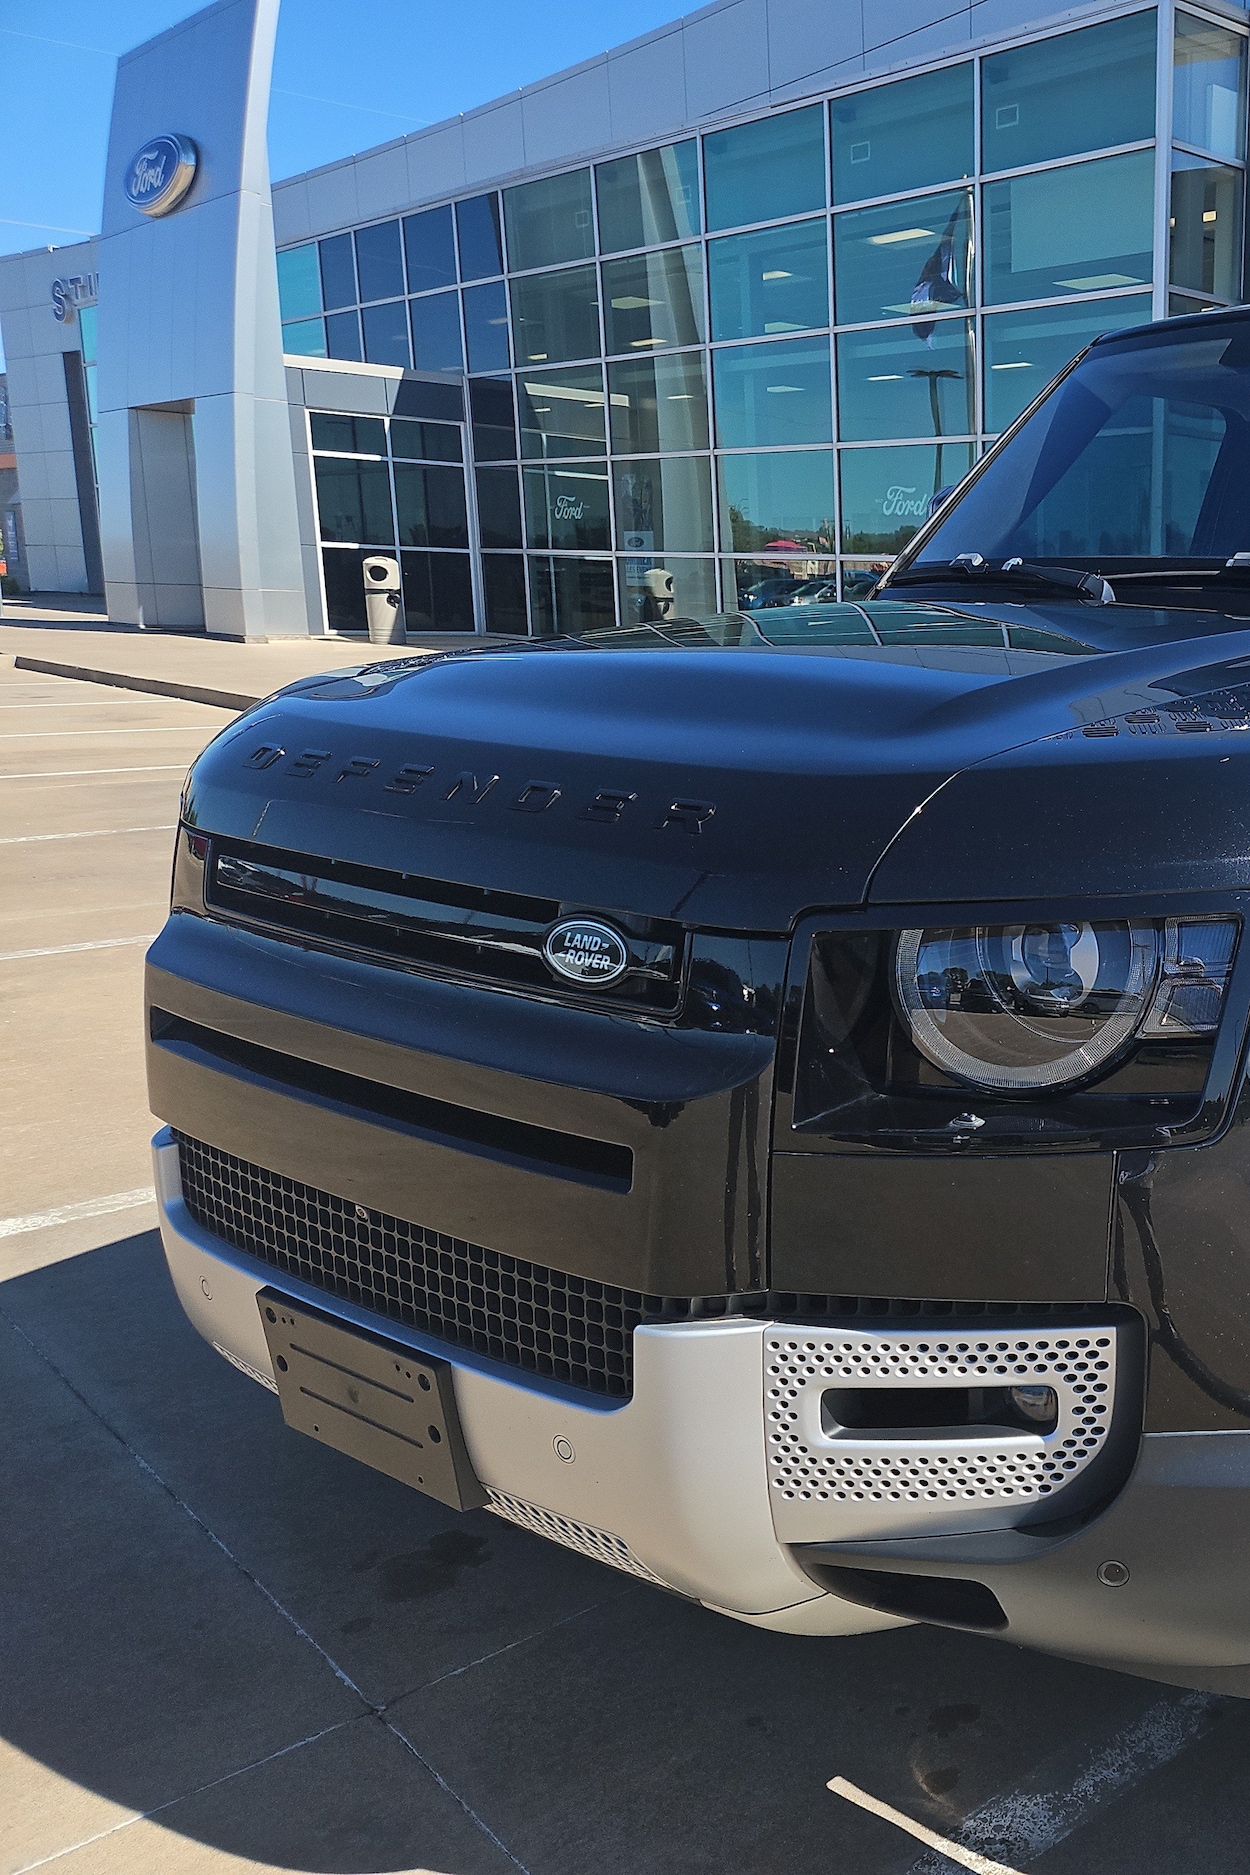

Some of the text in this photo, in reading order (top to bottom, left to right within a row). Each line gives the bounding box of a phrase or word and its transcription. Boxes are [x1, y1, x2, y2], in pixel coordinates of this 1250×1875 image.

[132, 151, 166, 197] Ford
[554, 495, 583, 520] Ford
[883, 486, 927, 516] Ford
[242, 741, 717, 835] DEFENDER
[564, 932, 602, 951] LAND
[565, 949, 611, 971] ROVER
